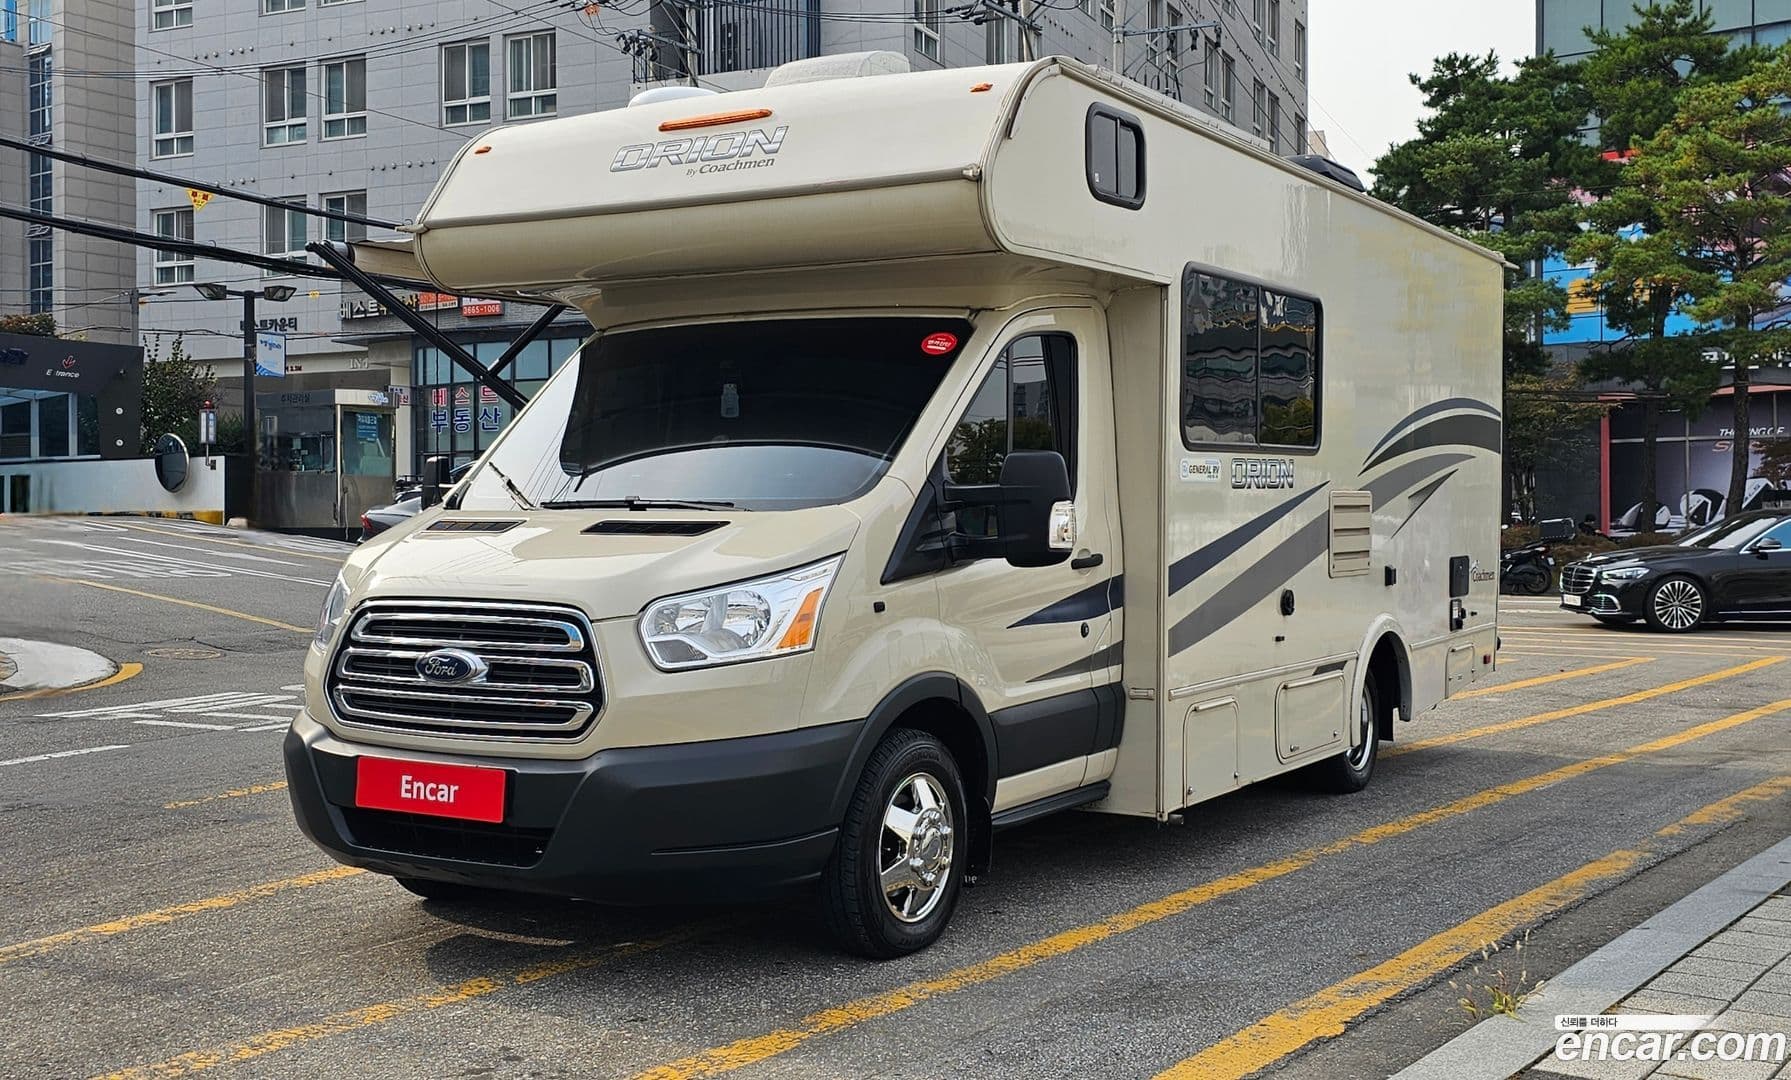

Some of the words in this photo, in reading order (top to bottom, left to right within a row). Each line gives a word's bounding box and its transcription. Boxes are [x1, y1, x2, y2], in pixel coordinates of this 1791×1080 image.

[610, 126, 789, 172] ORION
[686, 167, 698, 177] By
[699, 158, 775, 174] Coachmen
[432, 386, 499, 407] 베스트
[431, 406, 502, 434] 부동산
[1189, 465, 1211, 474] GENERAL
[1231, 458, 1294, 489] ORION
[425, 656, 458, 677] Ford
[400, 775, 459, 803] Encar
